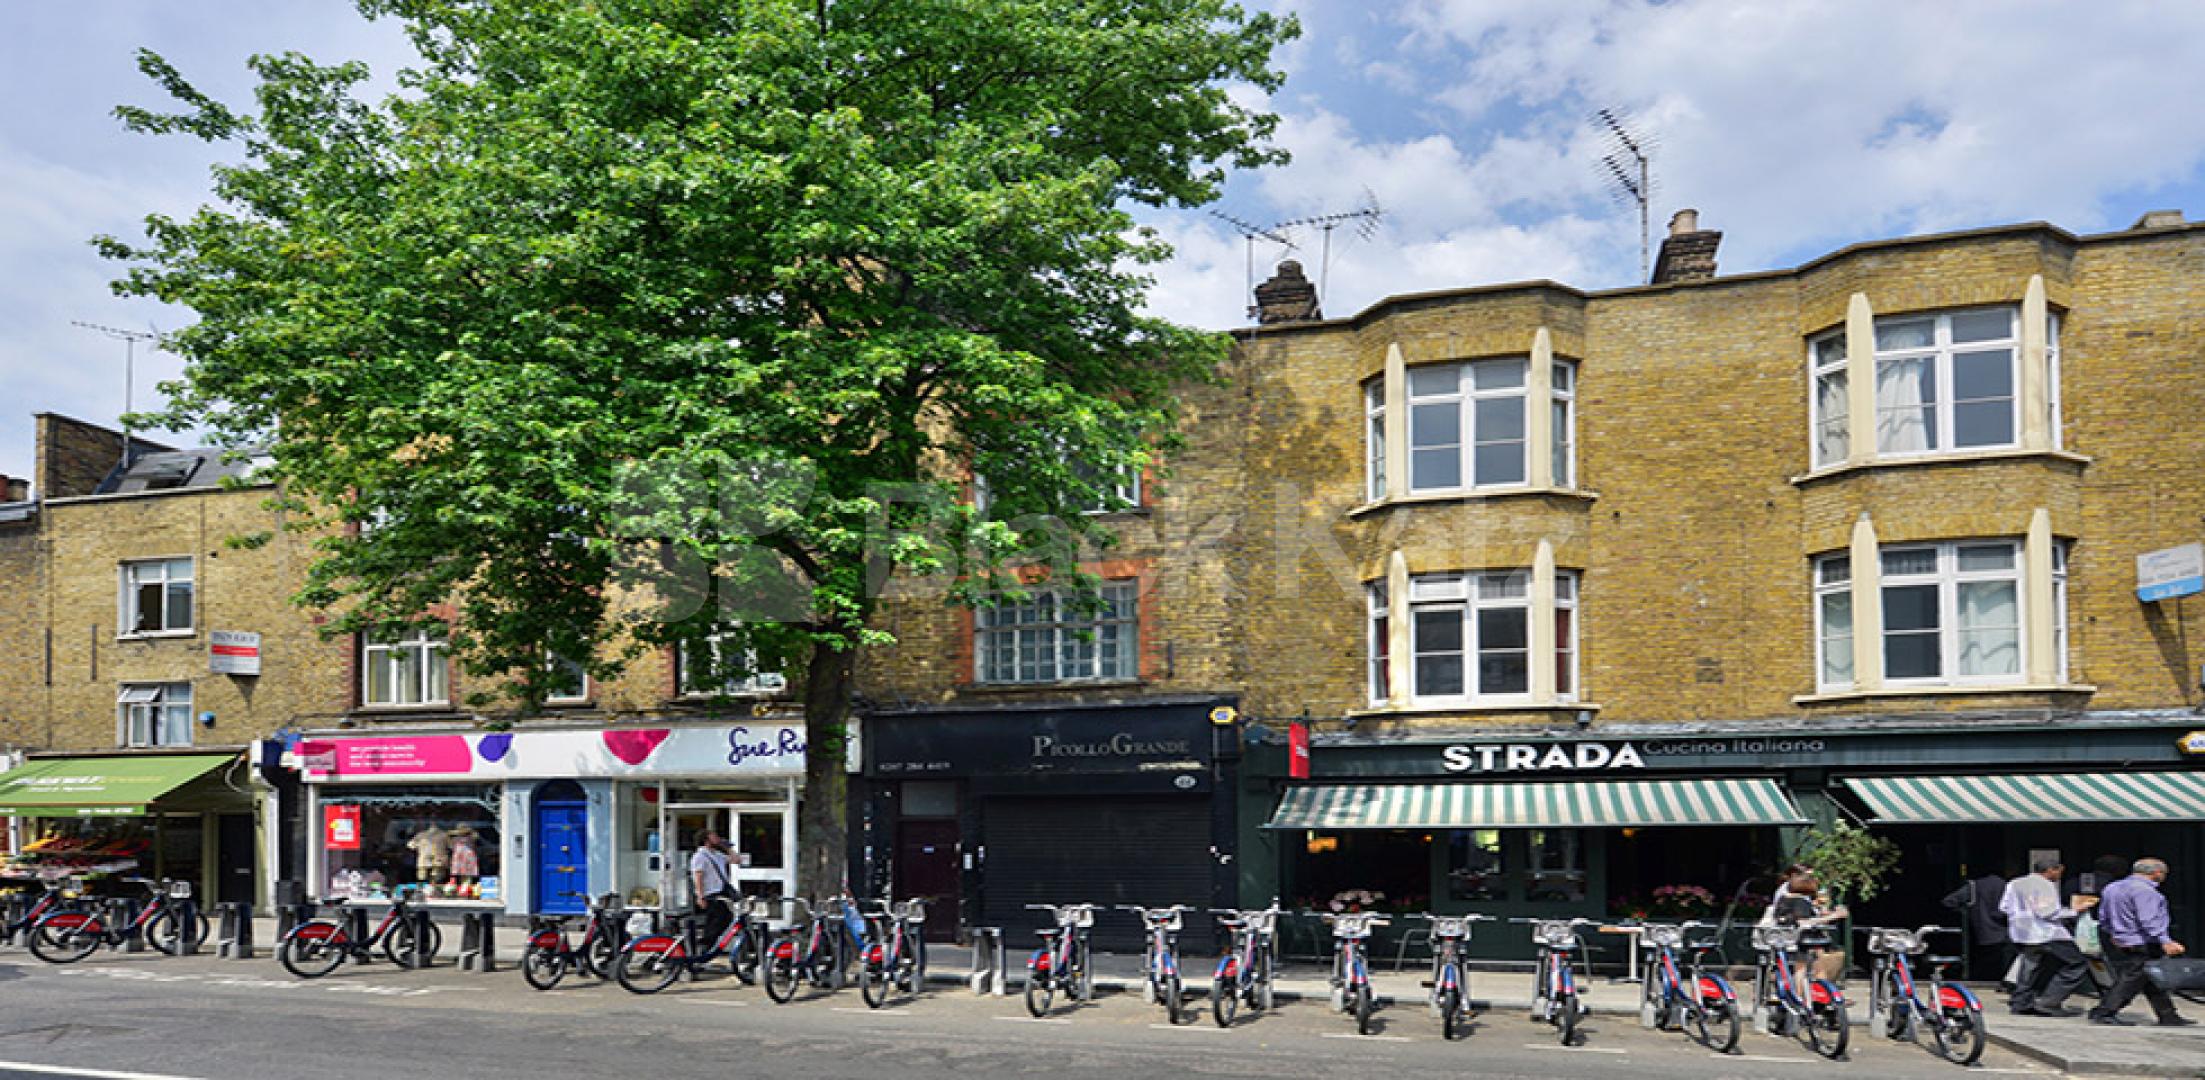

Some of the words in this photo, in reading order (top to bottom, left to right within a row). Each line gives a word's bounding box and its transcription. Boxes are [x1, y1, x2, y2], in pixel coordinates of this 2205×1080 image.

[728, 726, 776, 765] Sue
[1443, 742, 1646, 772] STRADA
[1643, 741, 1726, 754] Cucina
[1732, 737, 1825, 752] Italiana
